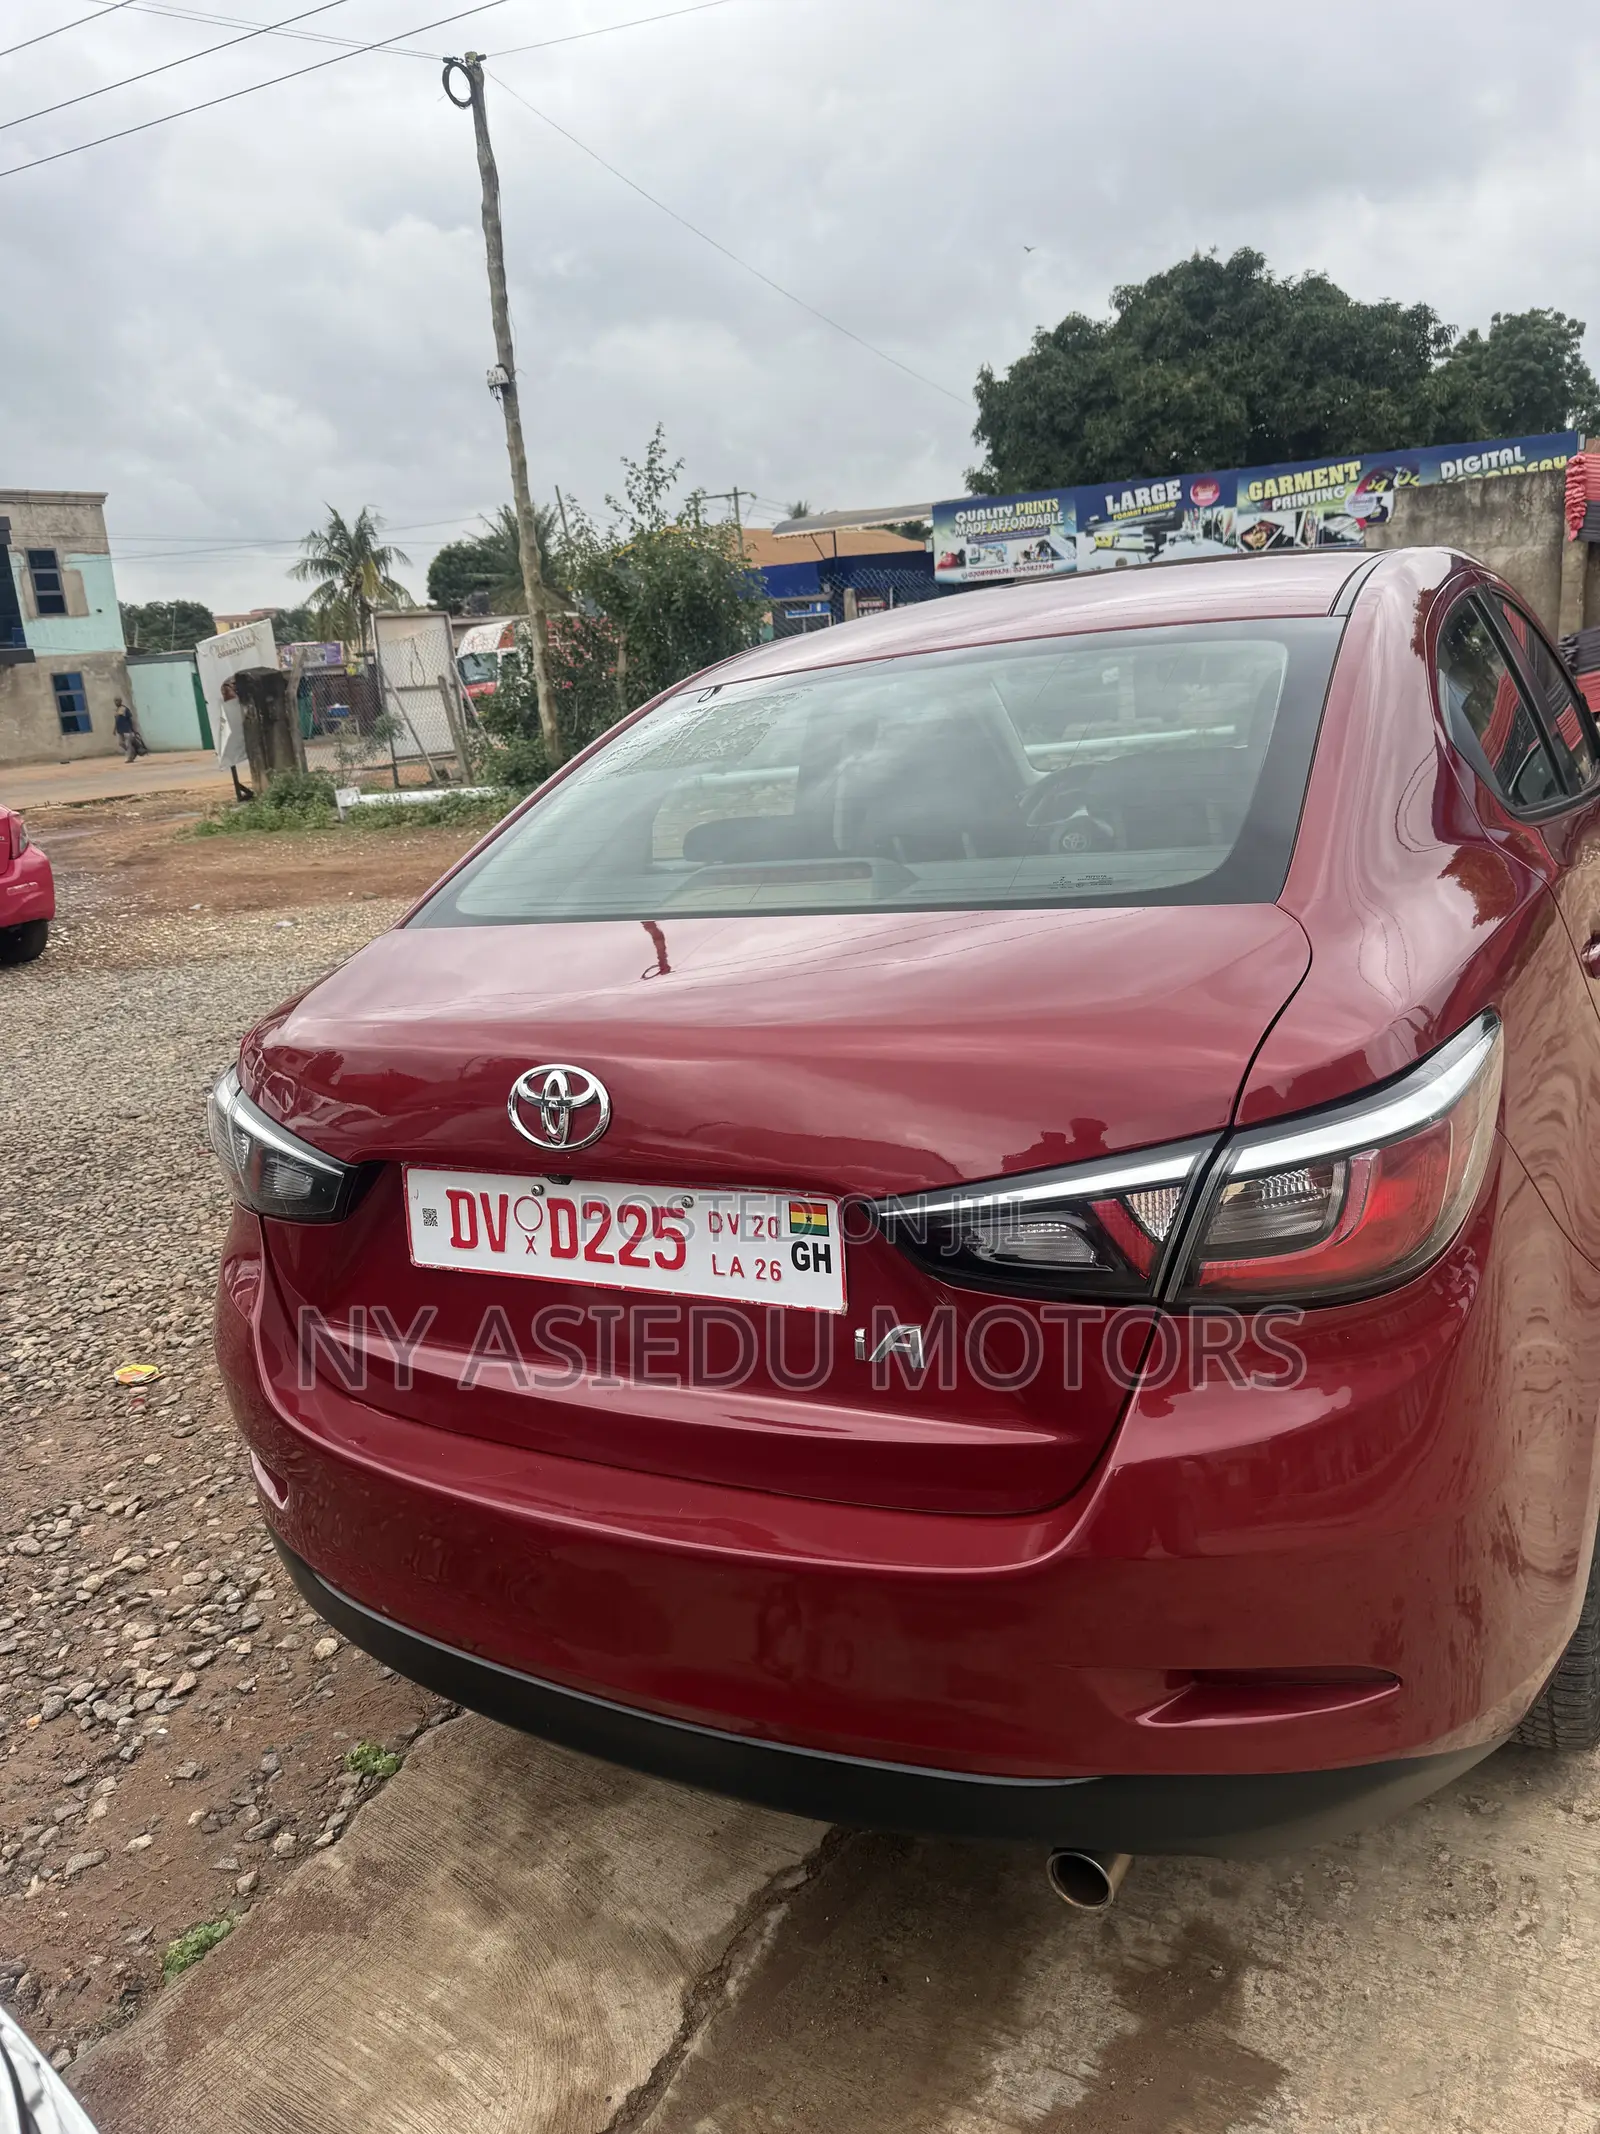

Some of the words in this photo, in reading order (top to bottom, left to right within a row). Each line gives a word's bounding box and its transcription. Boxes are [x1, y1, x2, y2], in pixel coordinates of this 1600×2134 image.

[1440, 445, 1526, 480] DIGITAL
[1105, 479, 1182, 516] LARGE
[1248, 460, 1362, 501] GARMENT
[954, 505, 1014, 524] QUALITY
[1015, 498, 1060, 517] PRINTS
[1271, 485, 1346, 512] PRINTING
[954, 521, 988, 538] MADE
[989, 511, 1065, 534] AFFORDABLE
[445, 1188, 509, 1253] DV
[546, 1196, 687, 1271] D225
[708, 1210, 741, 1235] DV
[752, 1214, 781, 1239] 20
[711, 1253, 745, 1278] LA
[754, 1257, 782, 1282] 26
[790, 1240, 833, 1274] GH
[854, 1324, 926, 1371] iA
